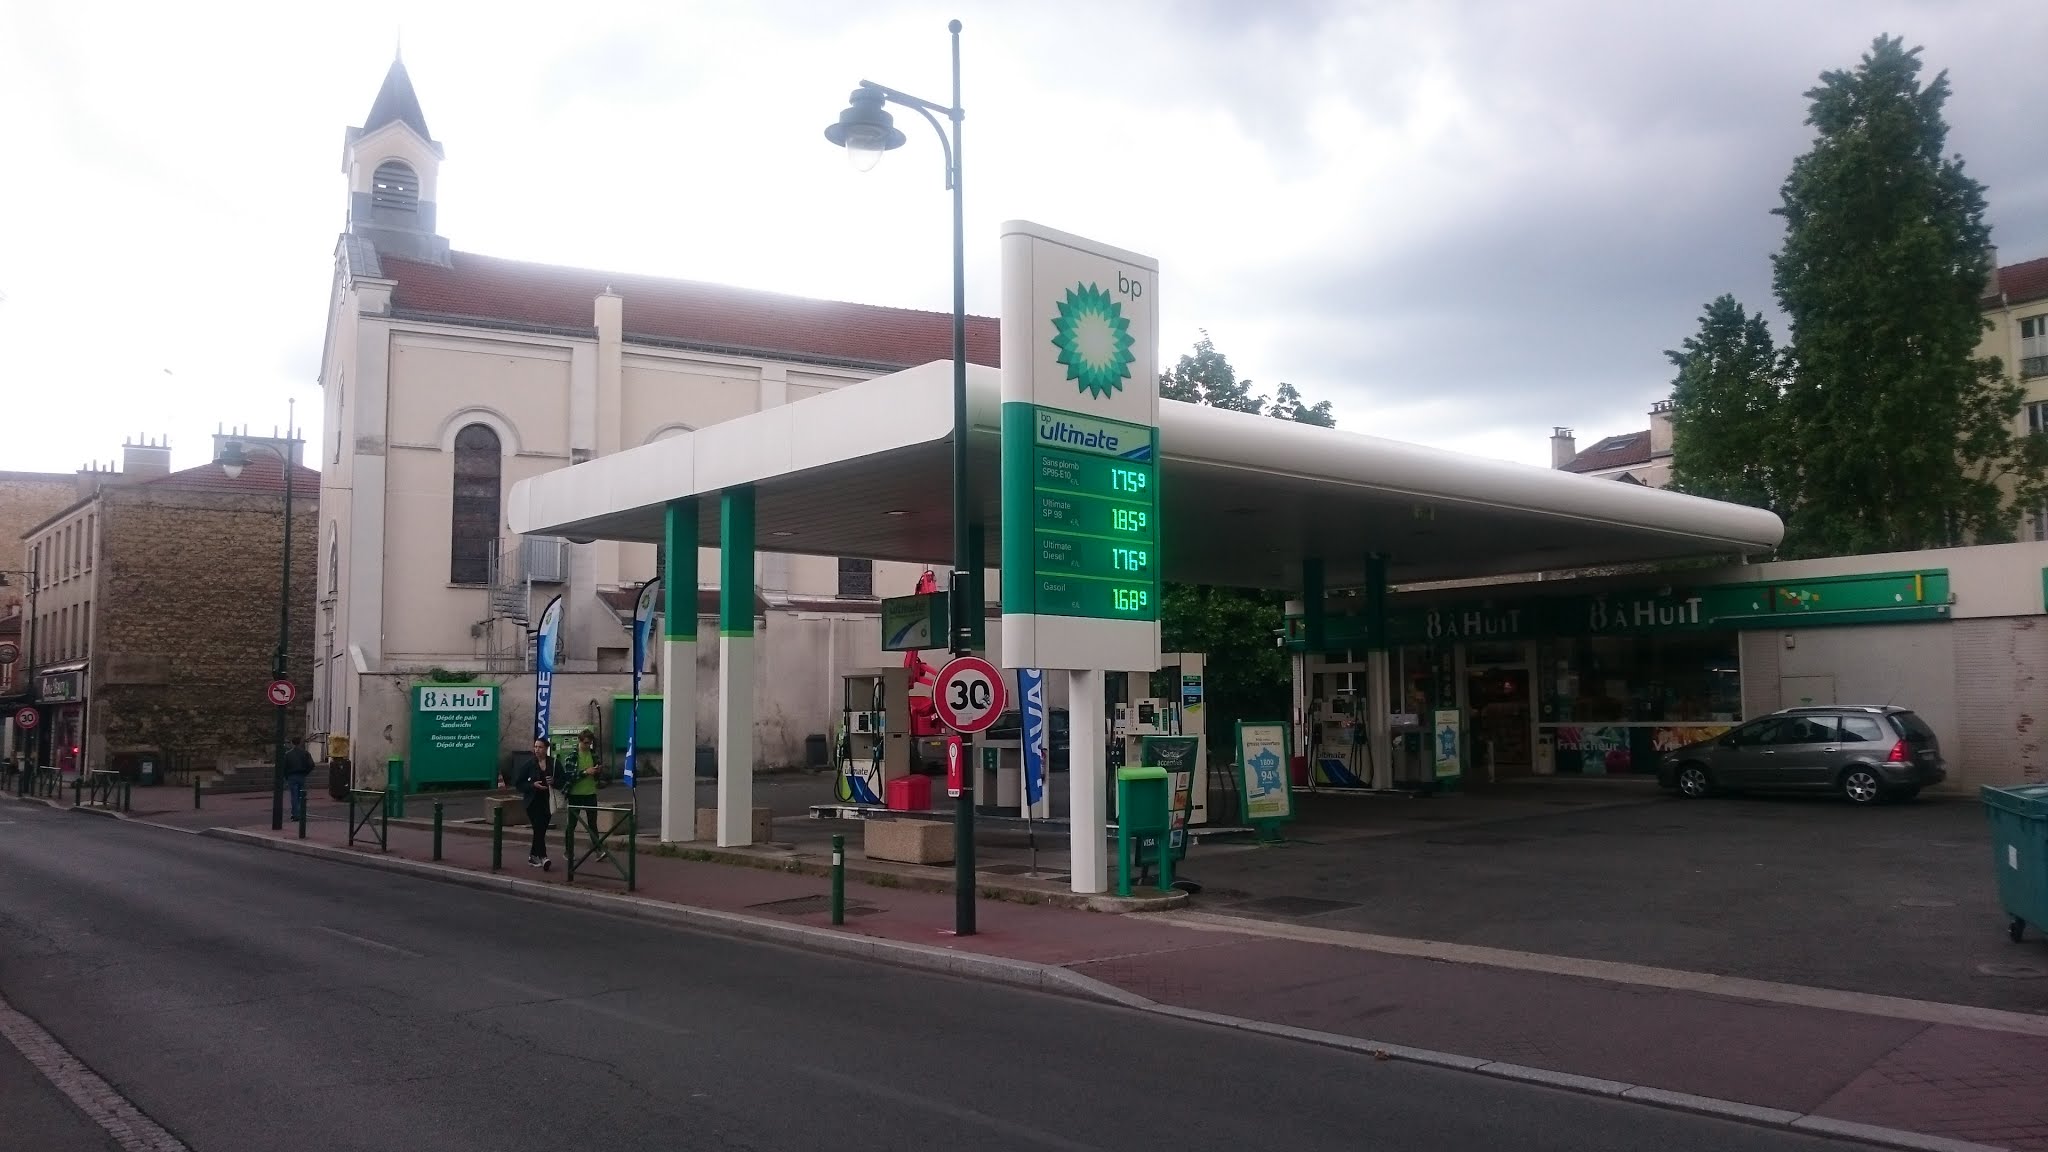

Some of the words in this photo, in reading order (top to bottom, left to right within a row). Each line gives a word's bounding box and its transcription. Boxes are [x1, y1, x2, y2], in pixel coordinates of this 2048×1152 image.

[1118, 270, 1142, 301] bp
[1040, 411, 1052, 424] bp
[1040, 421, 1119, 451] ultimate
[1042, 457, 1058, 467] Sans
[1059, 461, 1079, 471] plomb
[1042, 467, 1071, 479] SP95-E10
[1042, 499, 1071, 510] Ultimate
[1042, 509, 1052, 517] SP
[1053, 510, 1063, 519] 98
[1043, 540, 1072, 551] Ultimate
[1043, 550, 1065, 560] Diesel
[1043, 582, 1066, 592] Gasoil
[1589, 599, 1608, 631] 8
[1426, 607, 1441, 640] 8
[424, 691, 436, 708] 8
[950, 679, 991, 710] 30
[21, 713, 34, 723] 30
[436, 714, 455, 722] Dépôt
[463, 714, 478, 722] pain
[436, 741, 455, 749] Dépôt
